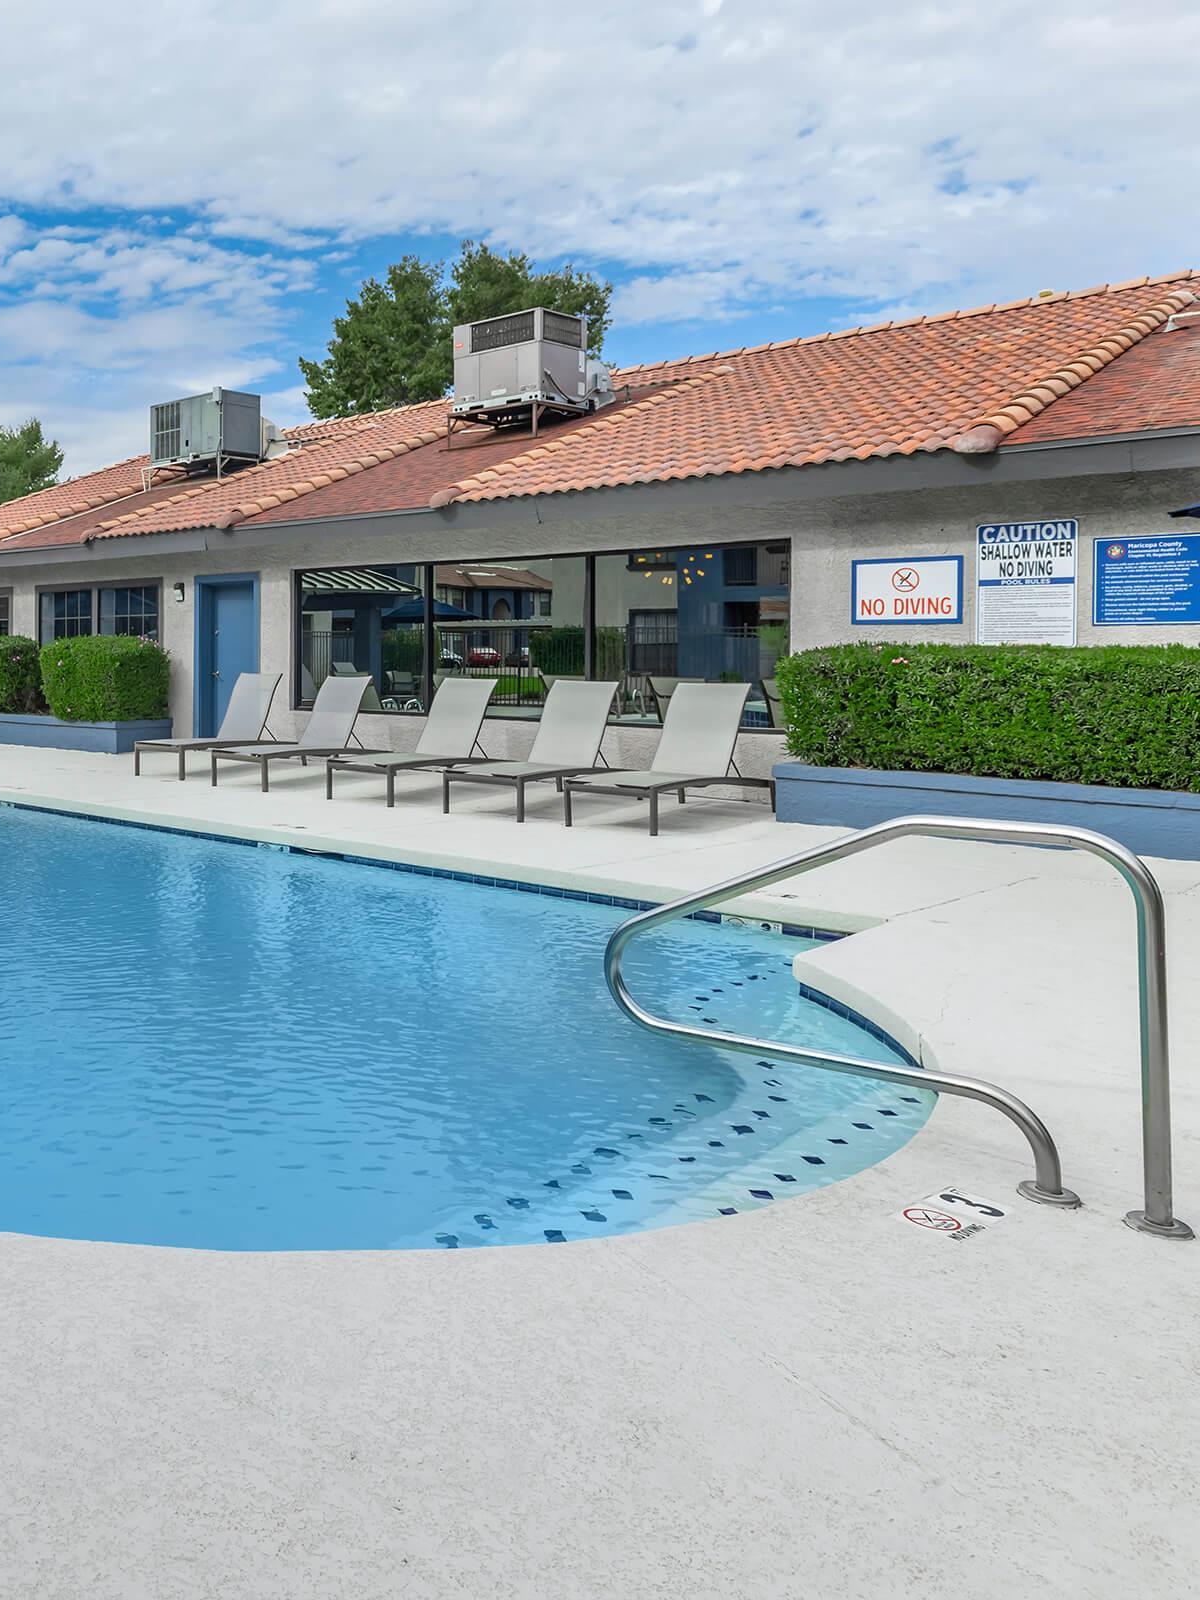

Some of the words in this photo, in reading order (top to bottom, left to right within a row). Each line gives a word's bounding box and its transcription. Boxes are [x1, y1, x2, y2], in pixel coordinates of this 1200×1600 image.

[982, 522, 1072, 543] CAUTION
[981, 544, 1032, 561] SHALLOW
[1034, 541, 1073, 558] WATER
[1159, 541, 1183, 549] County
[999, 562, 1015, 577] NO
[1017, 560, 1053, 577] DIVING
[860, 598, 885, 616] NO
[894, 596, 952, 615] DIVING
[940, 1194, 1005, 1217] 3
